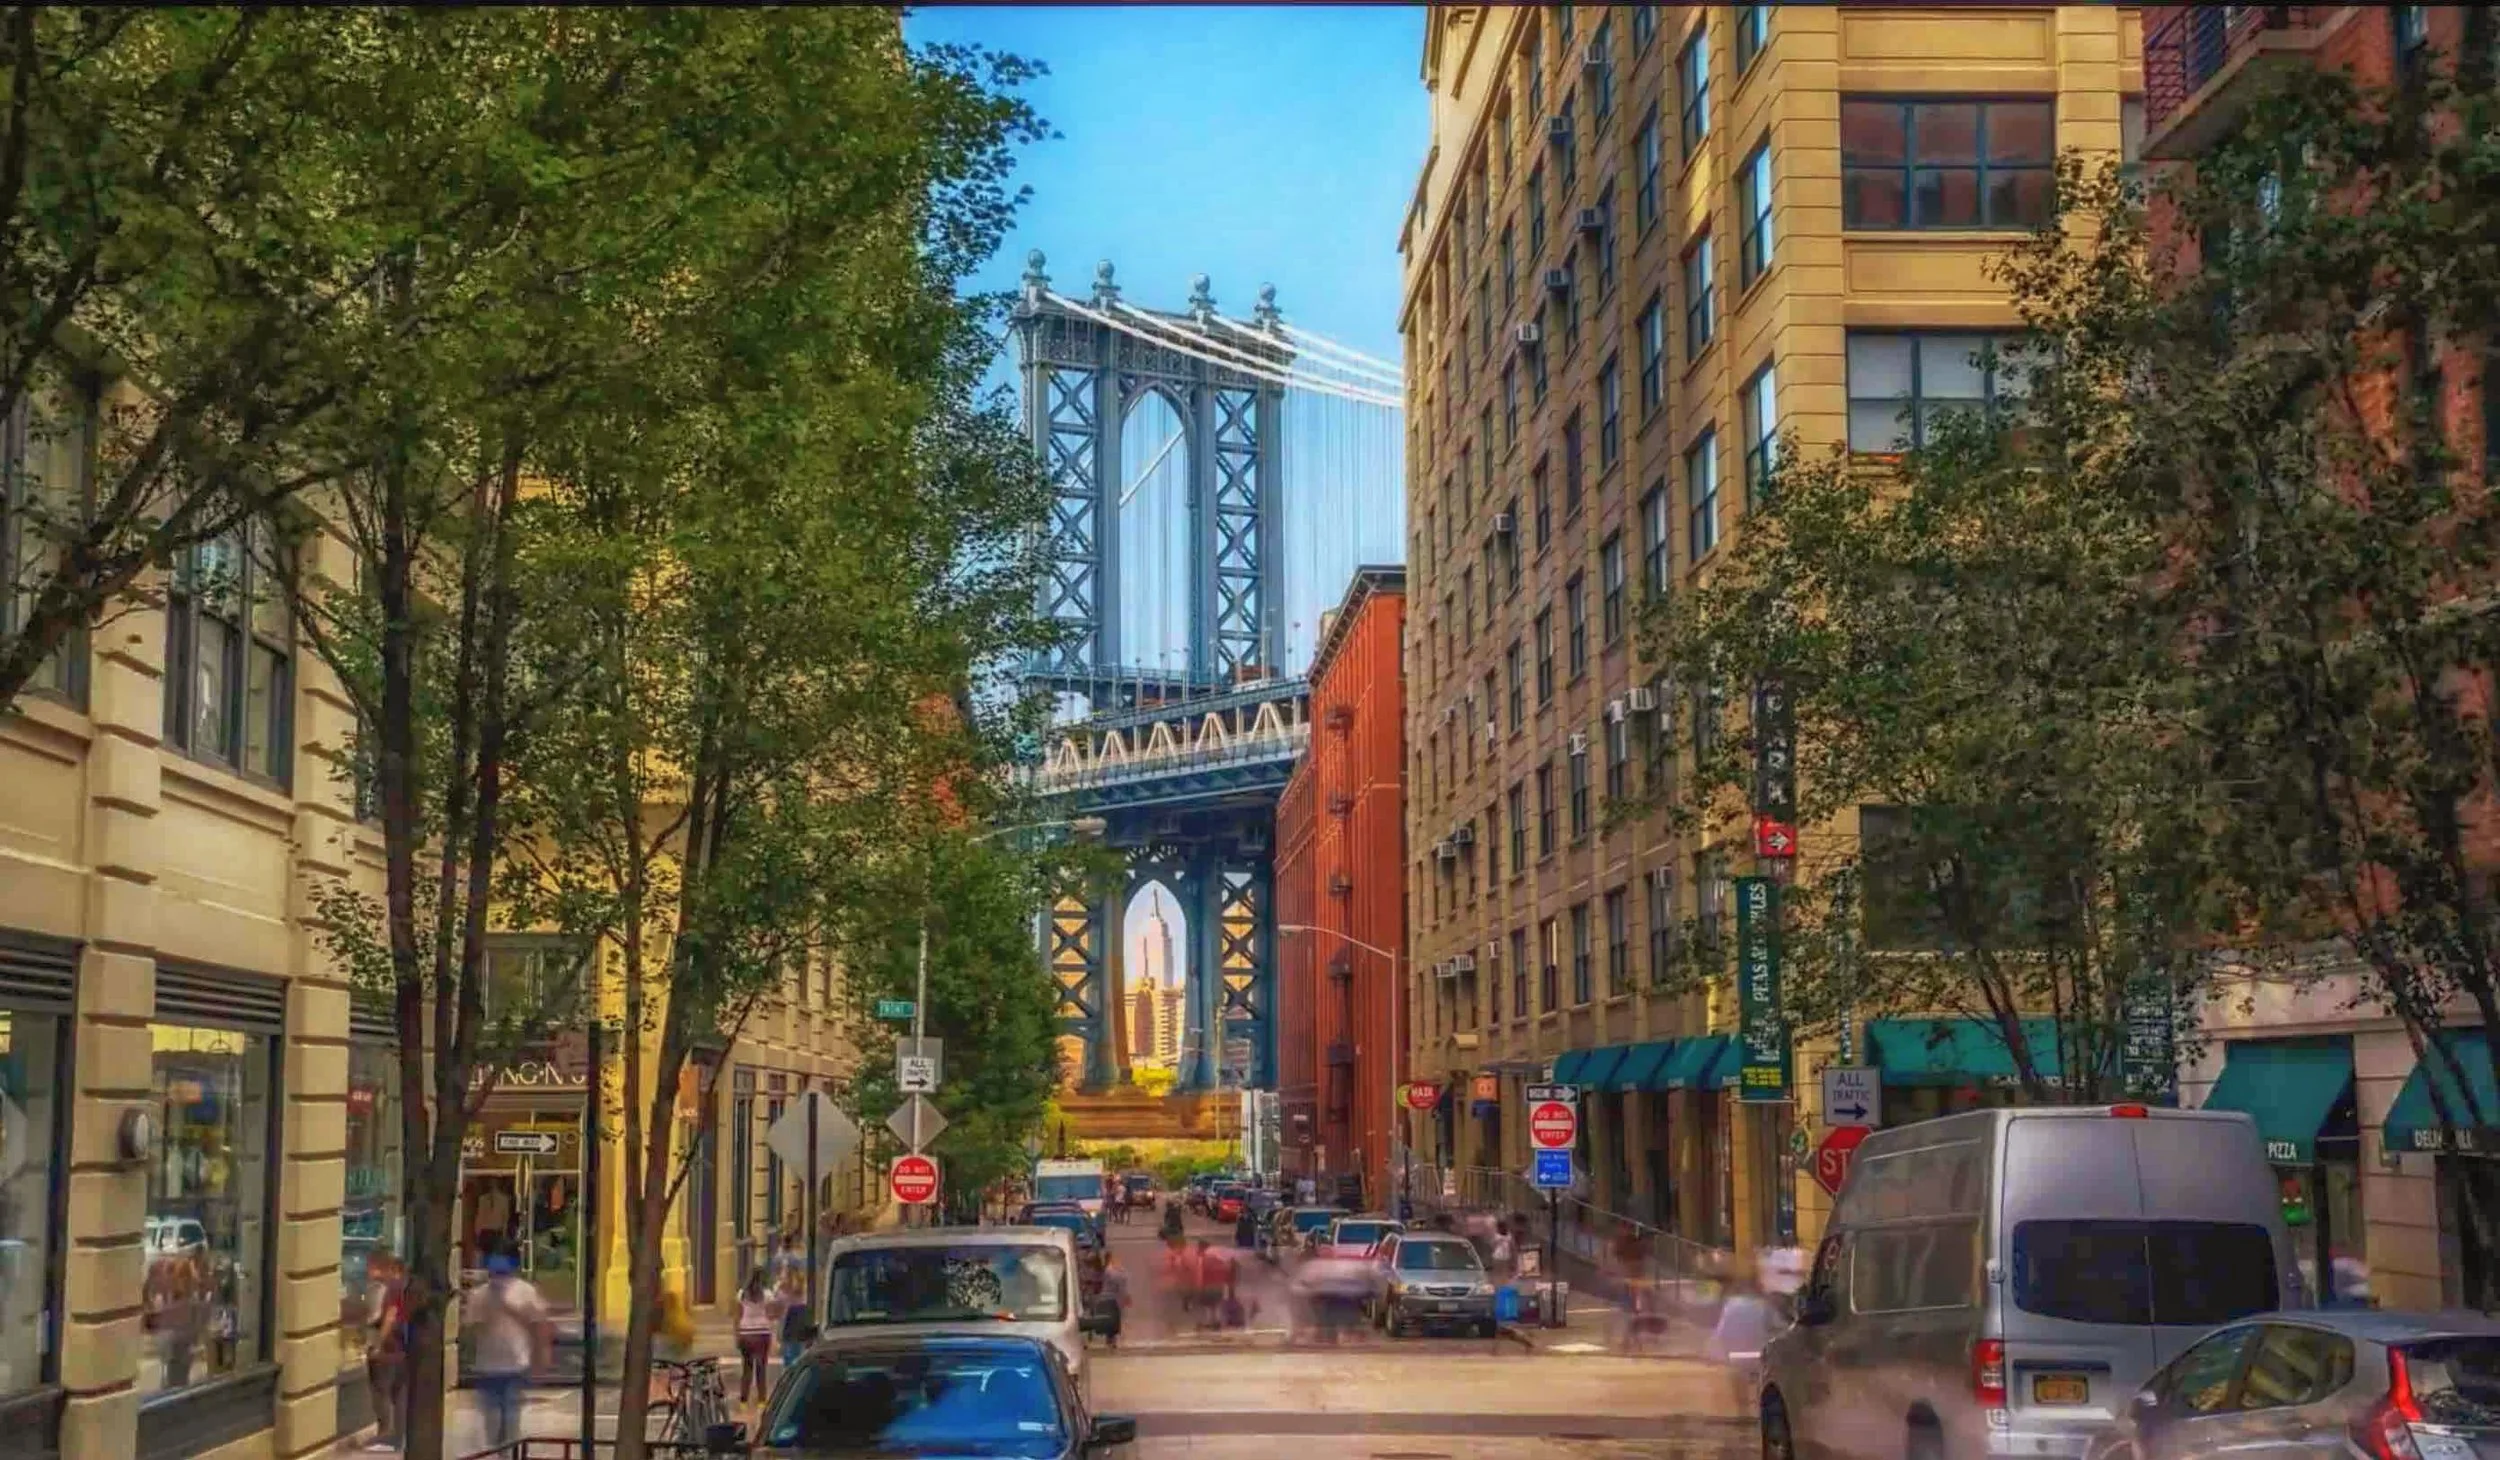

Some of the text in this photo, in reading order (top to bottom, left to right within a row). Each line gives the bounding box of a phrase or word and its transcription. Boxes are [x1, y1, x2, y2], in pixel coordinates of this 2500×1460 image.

[1752, 963, 1769, 1002] PEAS
[1838, 1072, 1863, 1086] ALL
[1833, 1090, 1869, 1101] TRAFFIC
[1540, 1130, 1568, 1140] ENTER
[2268, 1142, 2297, 1160] PIZZA
[898, 1165, 929, 1174] DO NOT
[900, 1186, 927, 1194] ENTER
